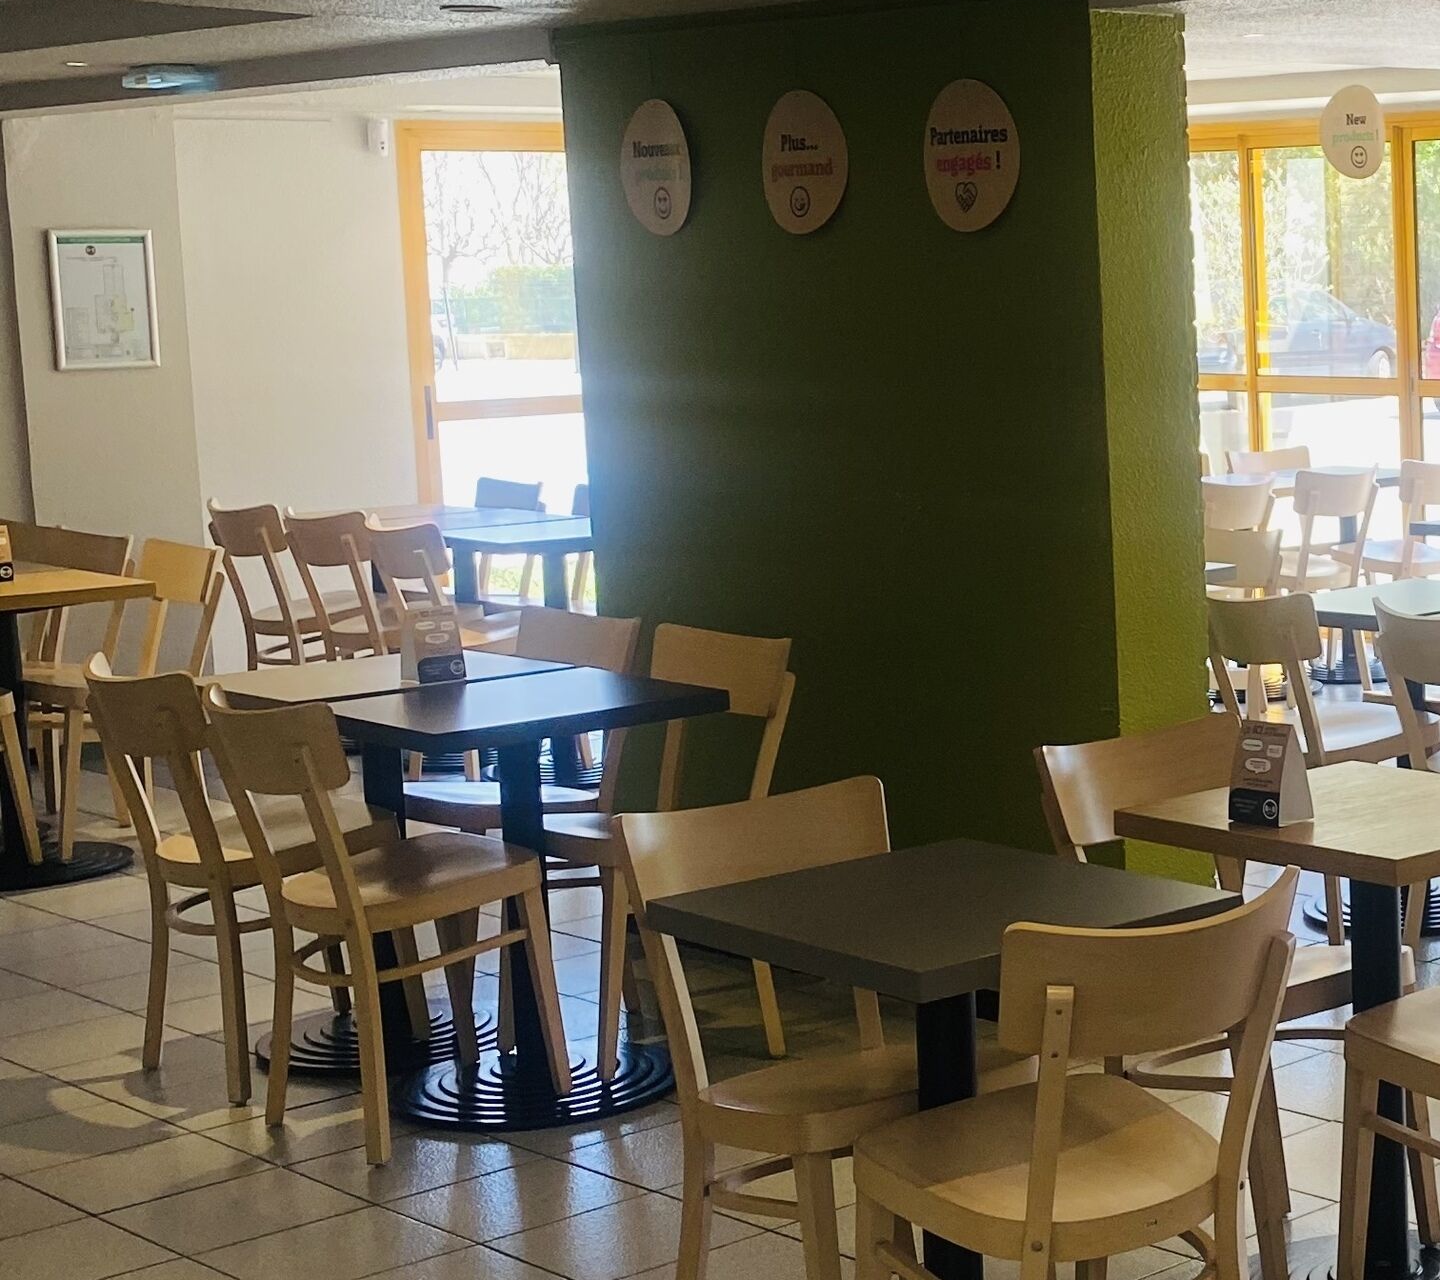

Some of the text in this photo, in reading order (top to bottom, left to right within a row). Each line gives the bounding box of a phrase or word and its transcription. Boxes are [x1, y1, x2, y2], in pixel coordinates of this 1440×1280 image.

[1345, 113, 1367, 126] New
[780, 134, 819, 153] Plus...
[929, 124, 1008, 146] Partenaires
[771, 157, 834, 183] gourmand
[936, 151, 992, 177] engagés
